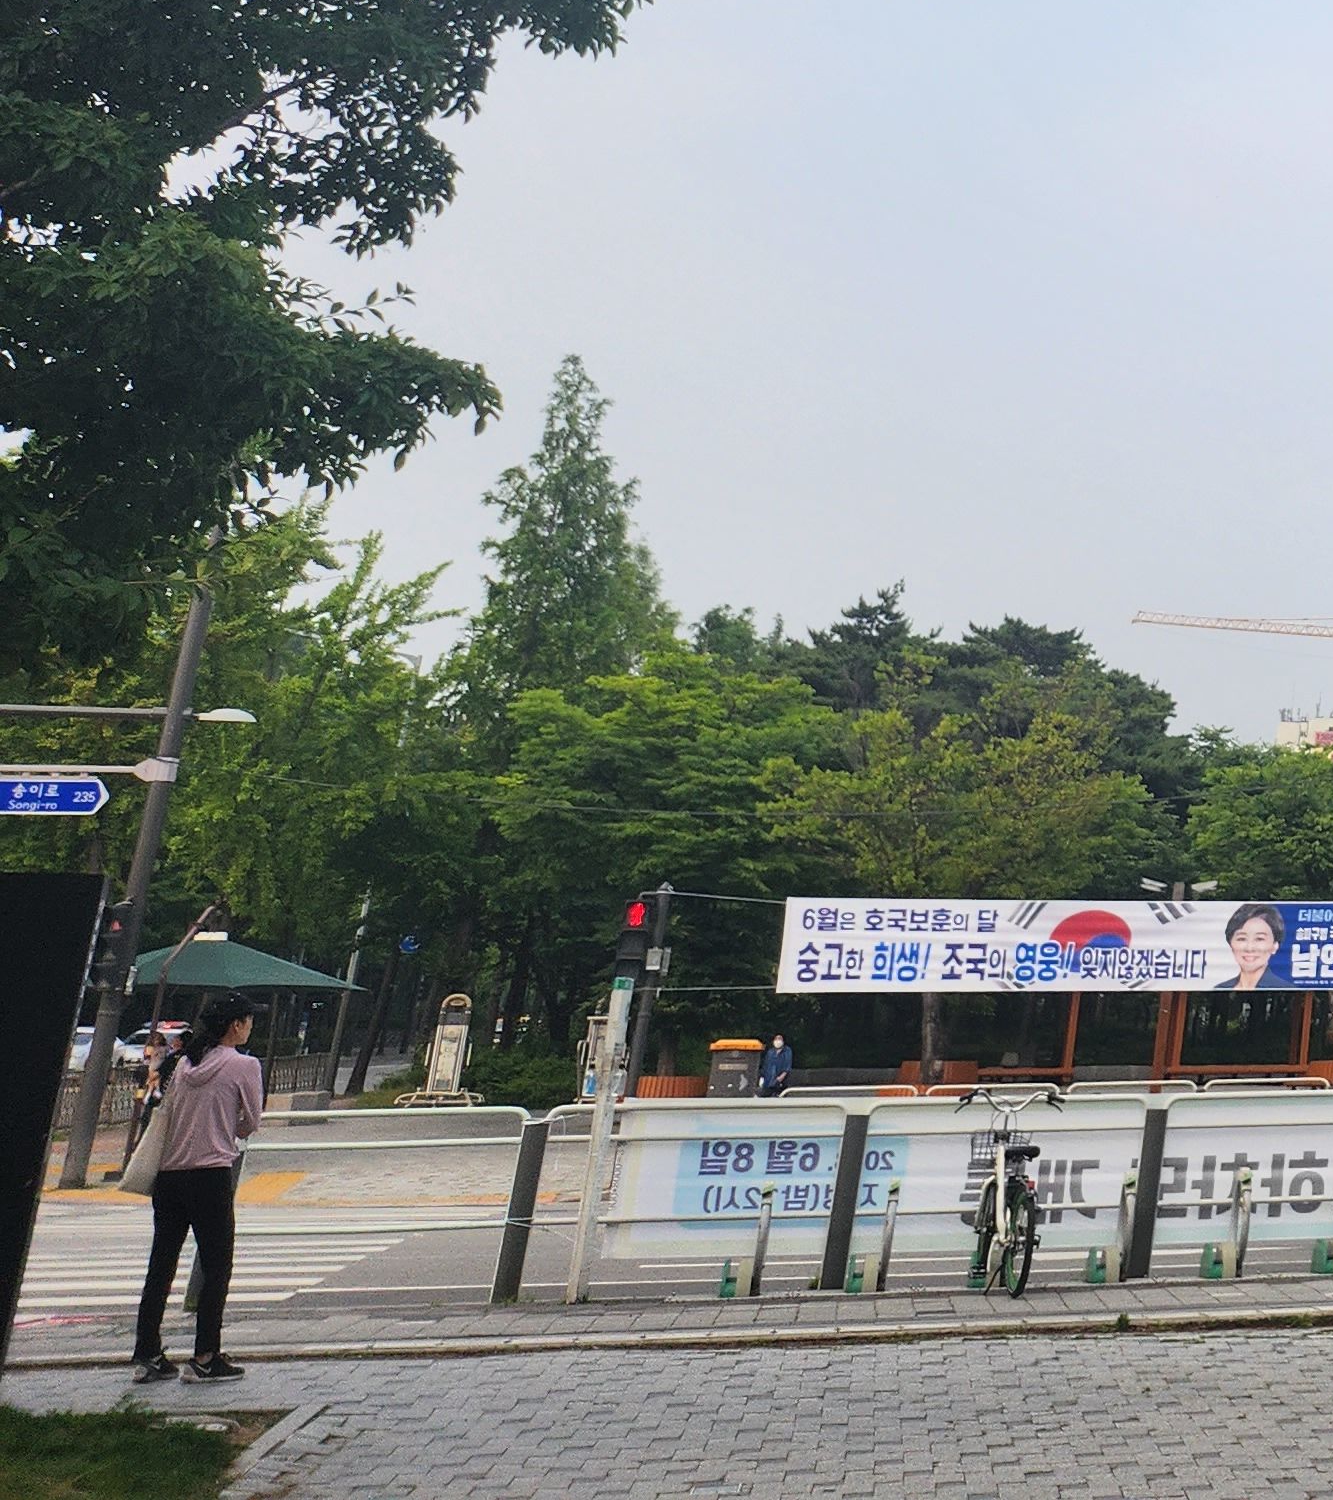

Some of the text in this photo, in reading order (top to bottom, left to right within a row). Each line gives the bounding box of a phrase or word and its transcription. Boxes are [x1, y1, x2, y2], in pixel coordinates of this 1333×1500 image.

[12, 783, 60, 799] 송이로
[72, 791, 97, 803] 235
[8, 799, 58, 812] Songi-ro
[802, 907, 998, 932] 6월은 호국보훈의 달
[796, 942, 864, 982] 숭고한
[871, 941, 931, 982] 희생!
[941, 942, 1007, 980] 조국의
[1014, 941, 1074, 982] 영웅!
